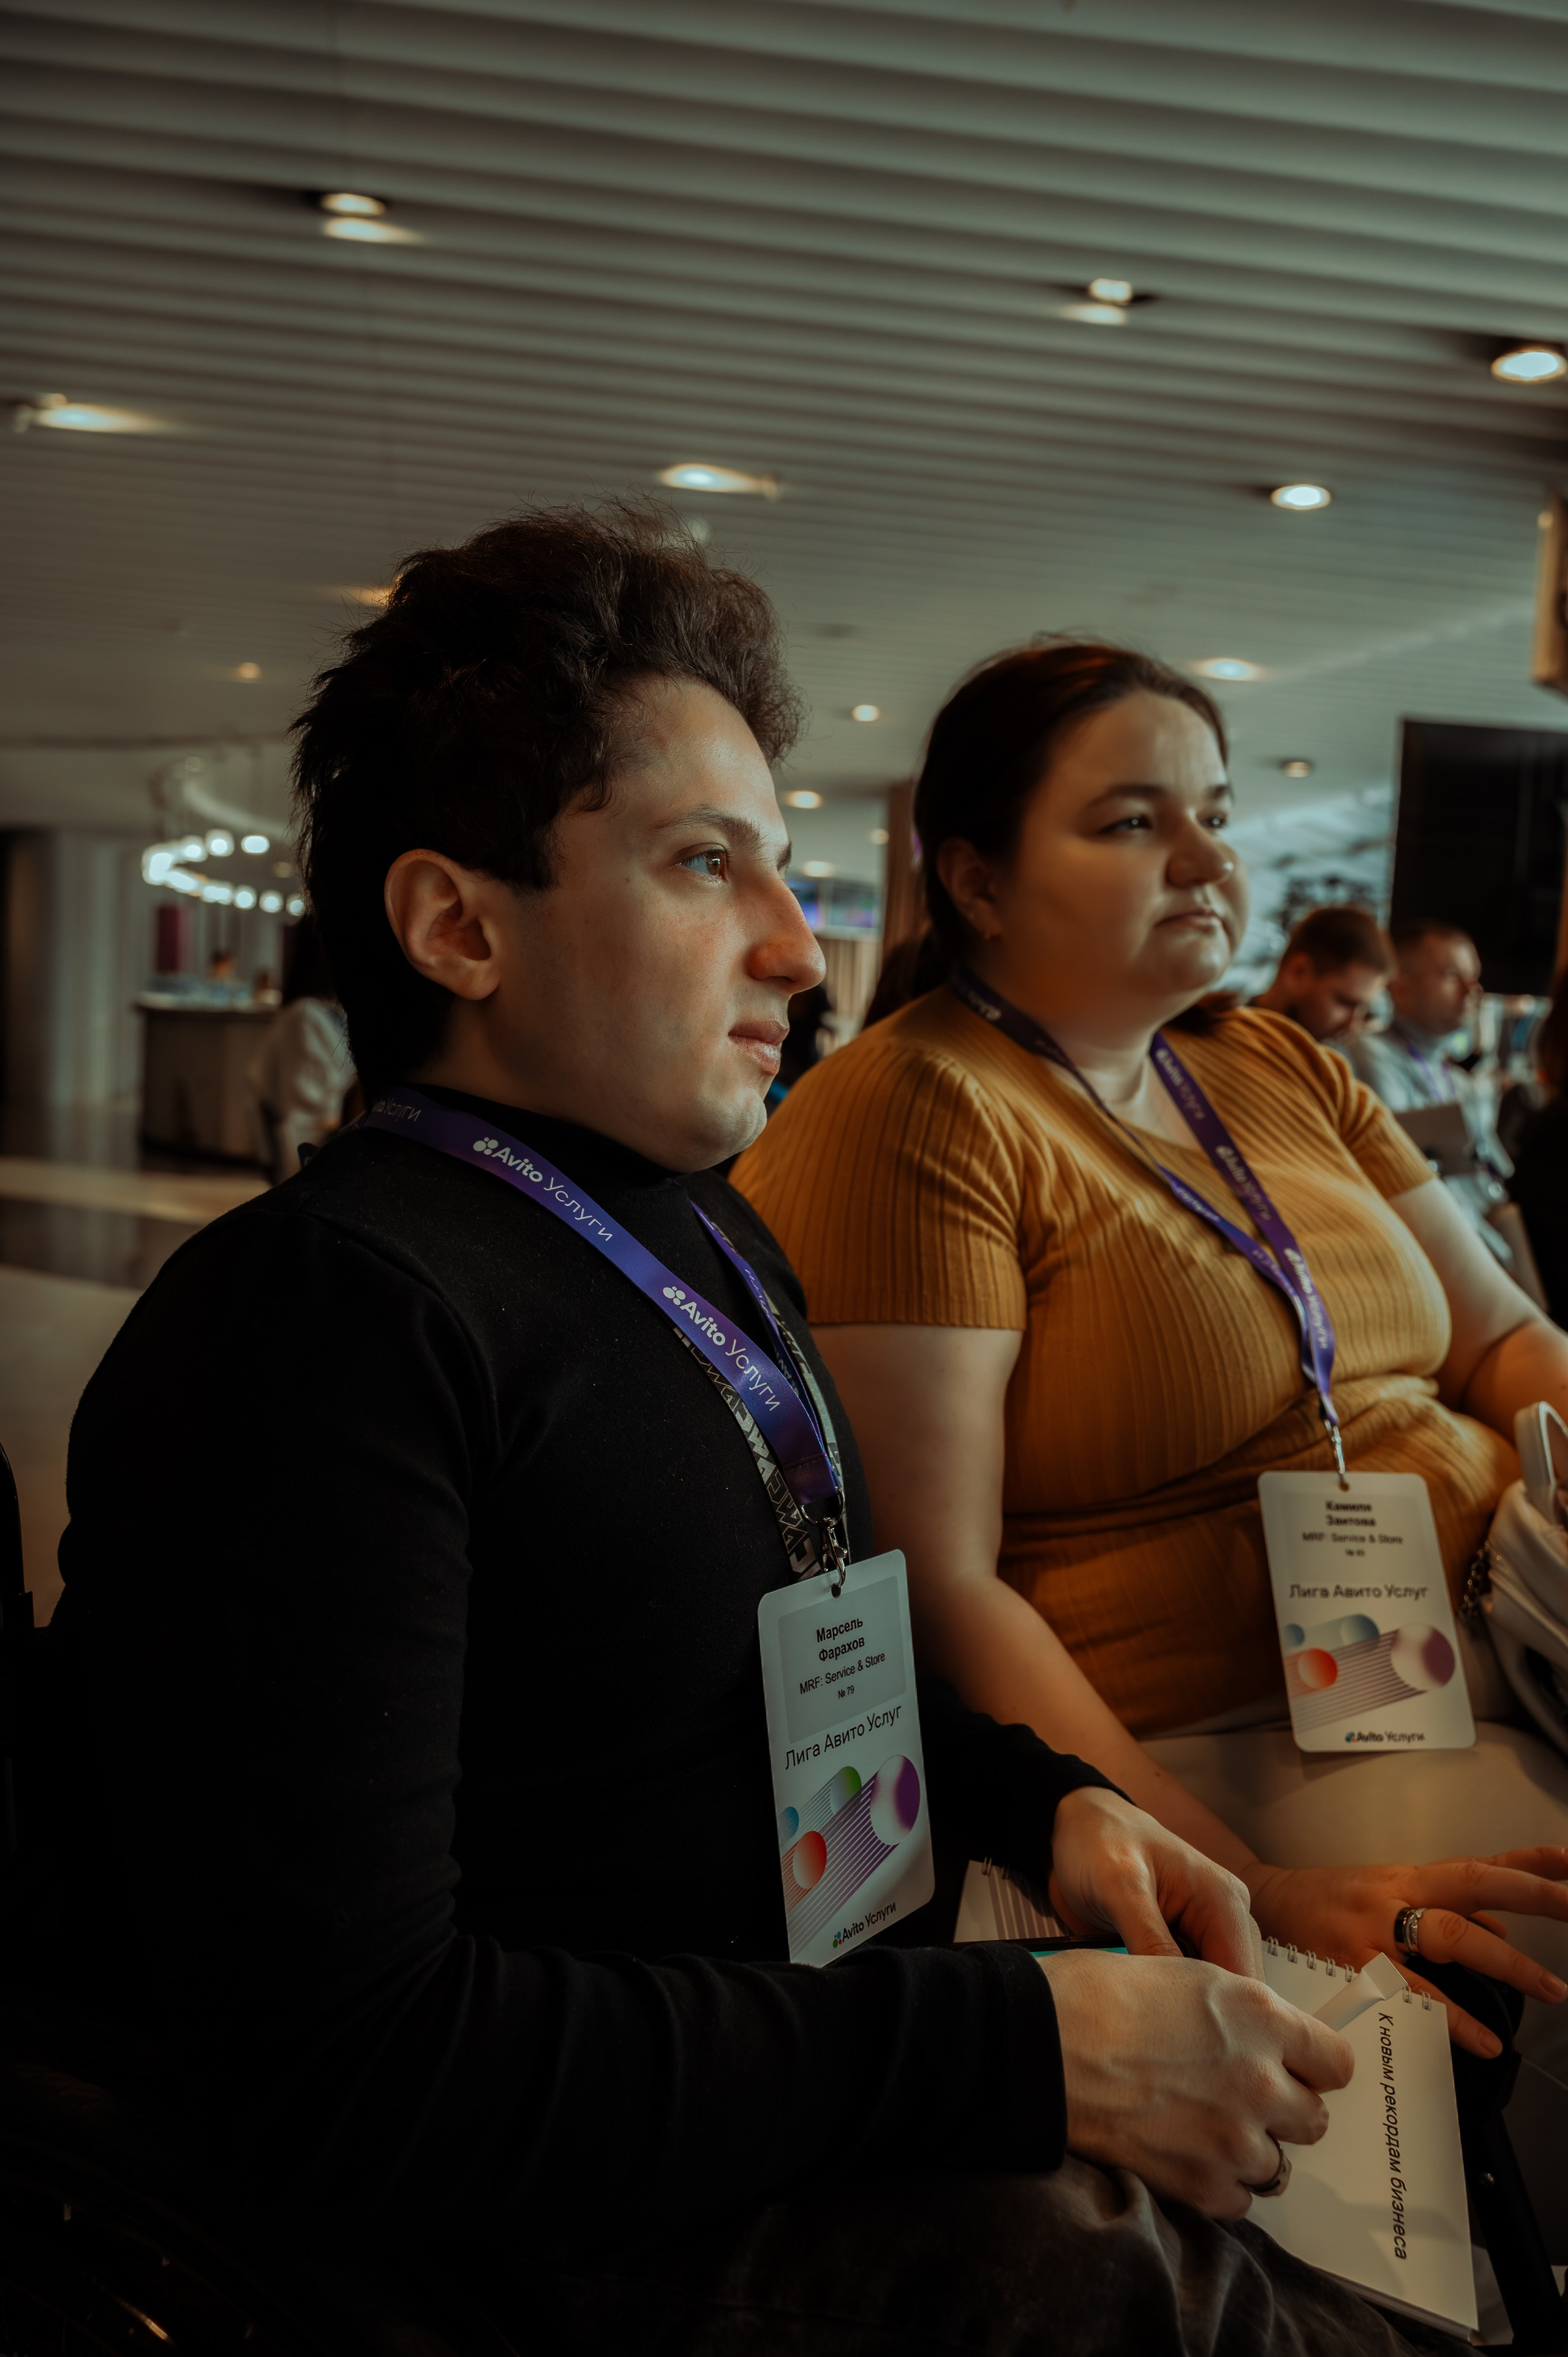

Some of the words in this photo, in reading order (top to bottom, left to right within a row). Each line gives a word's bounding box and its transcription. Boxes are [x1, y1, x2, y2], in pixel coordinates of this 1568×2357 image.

[383, 1096, 421, 1123] Услуги
[492, 1147, 543, 1183] Avito
[543, 1177, 613, 1242] Услуги
[679, 1301, 726, 1346] Avito
[725, 1338, 781, 1411] Услуги
[1289, 1584, 1329, 1599] Лига
[1333, 1584, 1382, 1599] Авито
[1384, 1584, 1428, 1601] Услуг
[816, 1618, 863, 1643] Марсель
[818, 1637, 865, 1662] Фарахов
[799, 1676, 823, 1695] MRF:
[825, 1665, 856, 1684] Service
[858, 1659, 864, 1672] &
[865, 1652, 886, 1669] Store
[846, 1685, 855, 1695] 79
[785, 1743, 821, 1770] Лига
[824, 1722, 865, 1753] Авито
[867, 1705, 902, 1732] Услуг
[842, 1921, 864, 1942] Avito
[865, 1902, 897, 1928] Услуги
[1378, 2012, 1394, 2025] К
[1379, 2025, 1395, 2081] новым
[1379, 2082, 1402, 2173] рекордам
[1390, 2175, 1408, 2260] бизнеса
